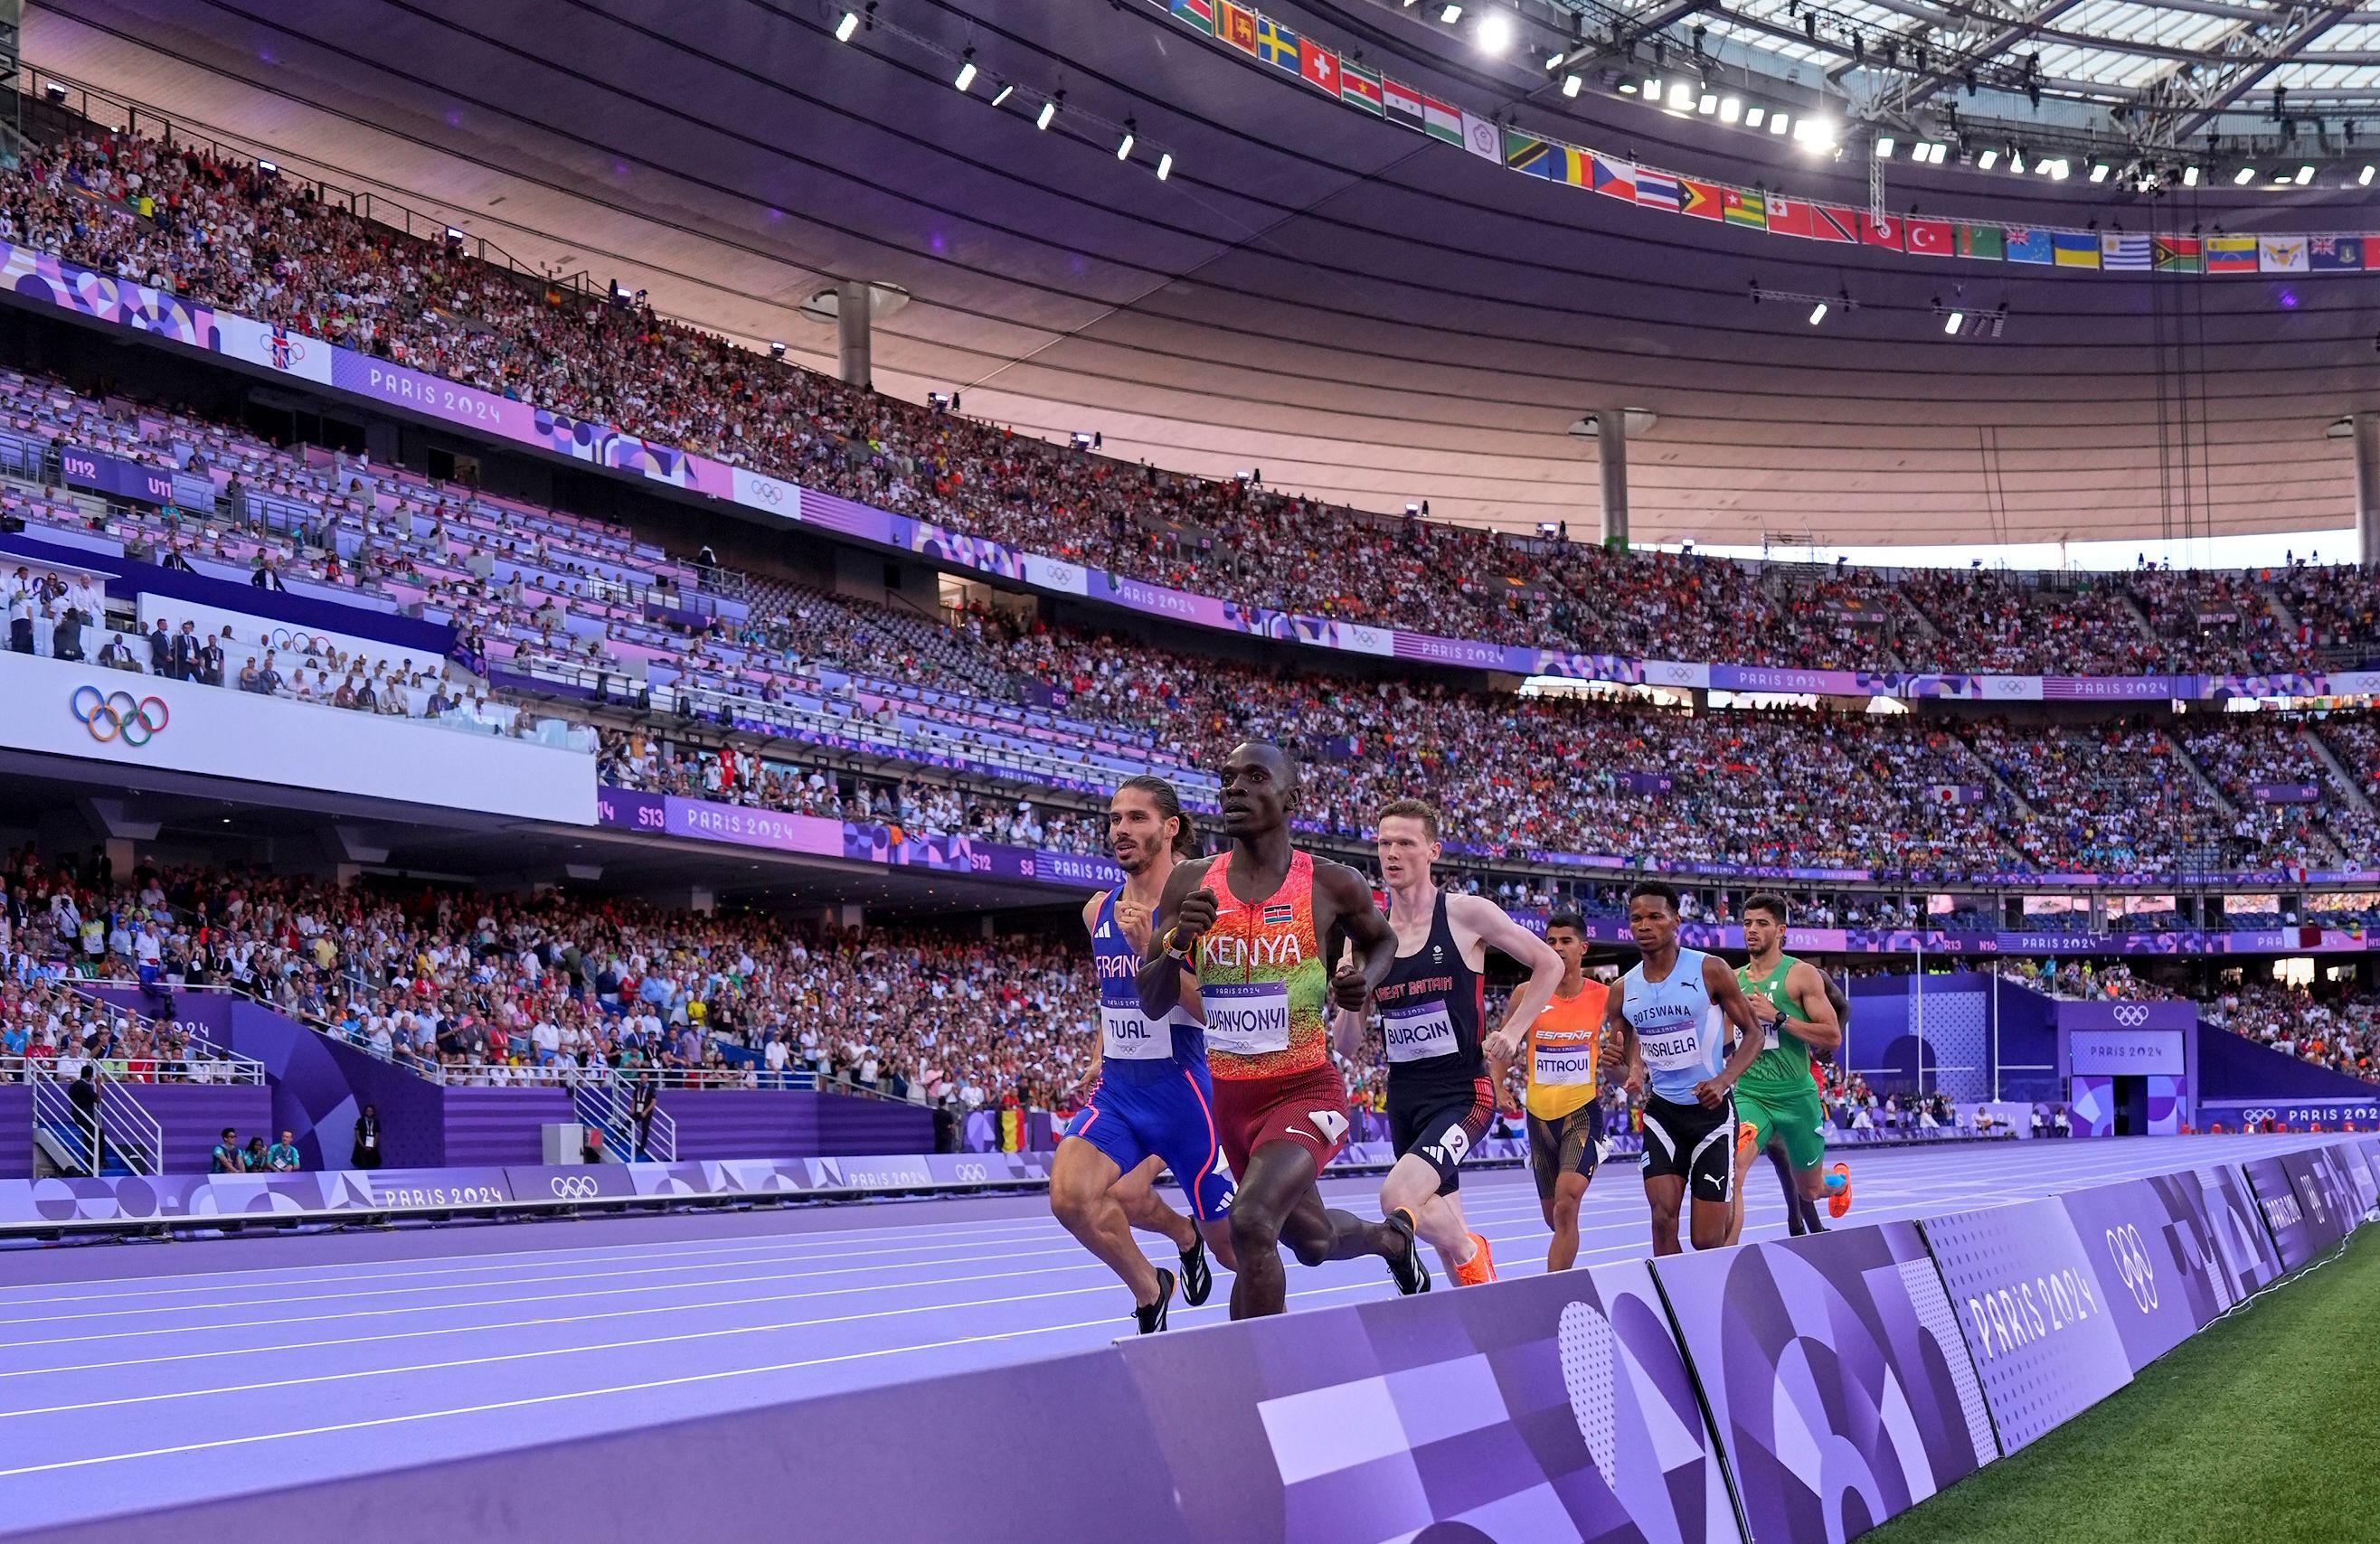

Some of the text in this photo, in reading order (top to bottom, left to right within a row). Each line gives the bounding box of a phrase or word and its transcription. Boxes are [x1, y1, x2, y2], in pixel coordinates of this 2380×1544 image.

[444, 391, 500, 423] 2024
[64, 457, 96, 479] U12
[147, 477, 172, 497] U11
[1159, 595, 1195, 615] 2024
[1467, 648, 1505, 664] 2024
[1786, 676, 1825, 687] 2024
[2126, 683, 2168, 694] 2024
[1659, 779, 1671, 789] R9
[638, 806, 665, 827] S13
[747, 816, 792, 840] 2024
[971, 852, 991, 871] S12
[1020, 860, 1034, 876] S8
[1203, 933, 1301, 966] KENYA
[1944, 939, 1961, 950] R13
[1979, 940, 1997, 950] N16
[2063, 938, 2096, 948] 2024
[1408, 976, 1453, 996] BRITAIN
[1207, 1007, 1285, 1032] WANYONYI
[1633, 1004, 1692, 1026] BOTSWANA
[1109, 1019, 1151, 1039] TUAL
[1387, 1020, 1450, 1045] BURGIN
[1535, 1031, 1592, 1041] ESPAÑA
[2129, 1046, 2162, 1057] 2024
[1536, 1058, 1588, 1072] ATTAOUI
[1450, 1134, 1464, 1153] 2
[892, 1172, 927, 1186] 2024
[451, 1187, 503, 1203] 2024
[2036, 1267, 2098, 1331] 2024
